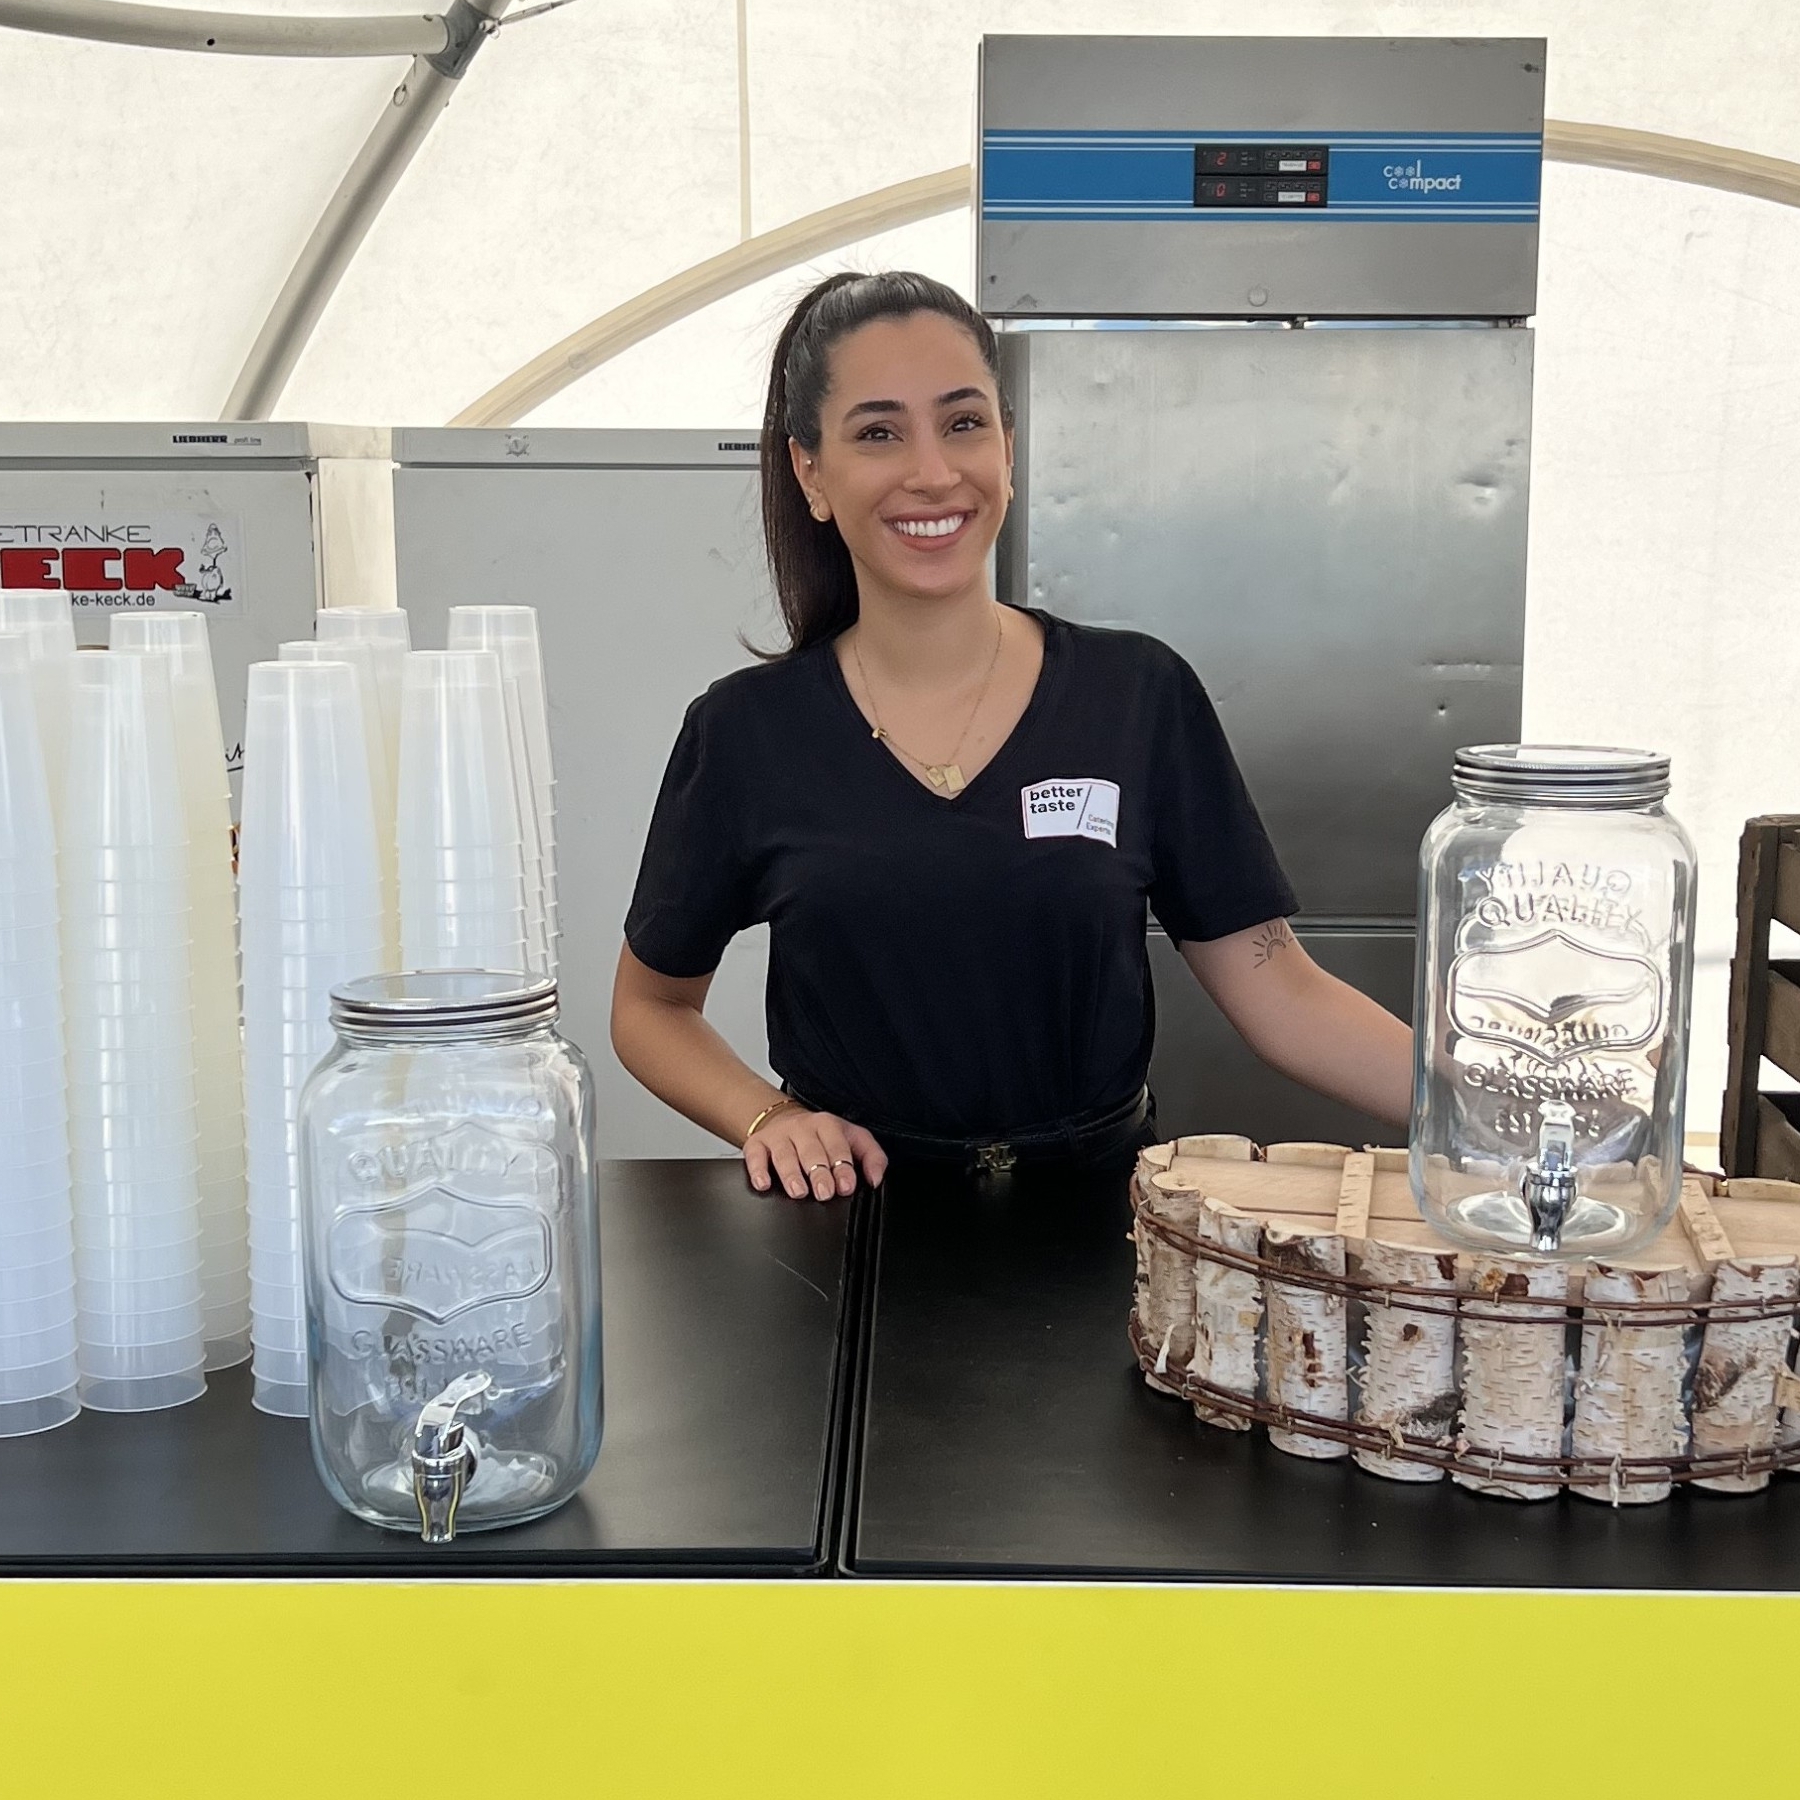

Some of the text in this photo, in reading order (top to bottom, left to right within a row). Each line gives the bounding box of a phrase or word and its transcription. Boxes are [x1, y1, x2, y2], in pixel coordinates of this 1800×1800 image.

[1216, 151, 1228, 166] 2
[1383, 159, 1421, 178] cool
[1388, 174, 1462, 194] compact
[172, 435, 228, 443] LIEBHERR
[718, 442, 762, 451] LIEBHE
[0, 525, 152, 543] ETRÄNKE
[0, 547, 185, 590] ECK
[71, 593, 156, 606] ke-keck.de
[1030, 786, 1083, 801] better
[1030, 800, 1076, 814] taste
